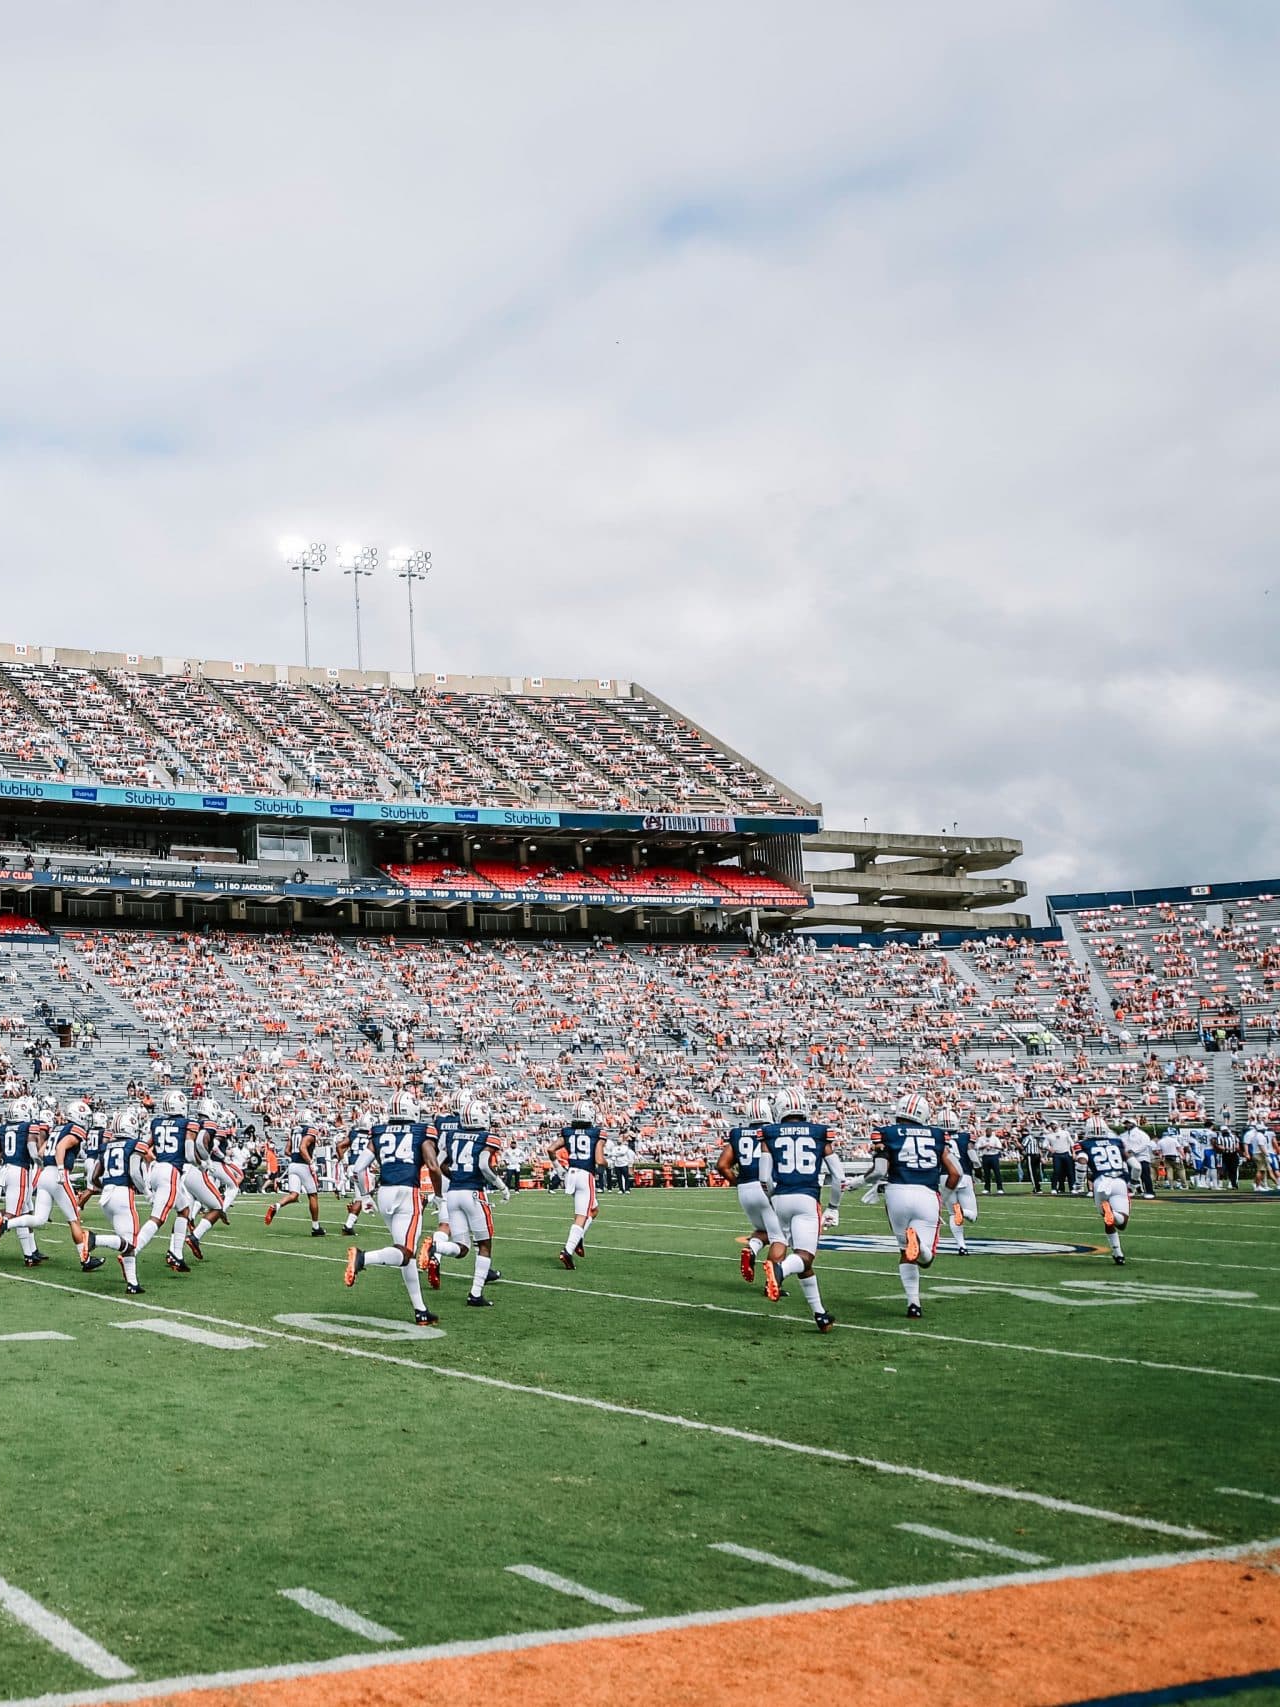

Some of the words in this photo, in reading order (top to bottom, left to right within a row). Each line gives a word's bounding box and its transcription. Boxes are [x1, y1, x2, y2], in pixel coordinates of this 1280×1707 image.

[124, 791, 176, 806] StubHub
[254, 800, 304, 814] StubHub
[380, 806, 429, 820] StubHub
[504, 811, 552, 826] StubHub
[668, 817, 698, 830] AUBURN
[703, 818, 730, 832] TIGERS
[12, 870, 33, 880] CLUB
[62, 874, 76, 883] PAT
[76, 876, 110, 884] SULLIVAN
[146, 879, 166, 888] TERRY
[167, 880, 196, 888] BEASLEY
[240, 883, 274, 892] JACKSON
[337, 887, 354, 895] 2013
[386, 888, 404, 896] 2010
[409, 889, 427, 897] 2004
[477, 892, 494, 900] 1987
[566, 894, 584, 902] 1919
[632, 896, 673, 904] CONFERENCE
[674, 896, 714, 904] CHAMPIONS
[775, 898, 808, 906] STADIUM
[780, 1127, 810, 1136] SIMPSON
[4, 1131, 16, 1156] 0
[154, 1126, 178, 1154] 35
[568, 1134, 590, 1160] 19
[379, 1133, 414, 1164] 24
[449, 1140, 474, 1172] 14
[774, 1136, 816, 1174] 36
[898, 1136, 938, 1168] 45
[102, 1147, 124, 1178] 13
[1090, 1145, 1122, 1170] 28
